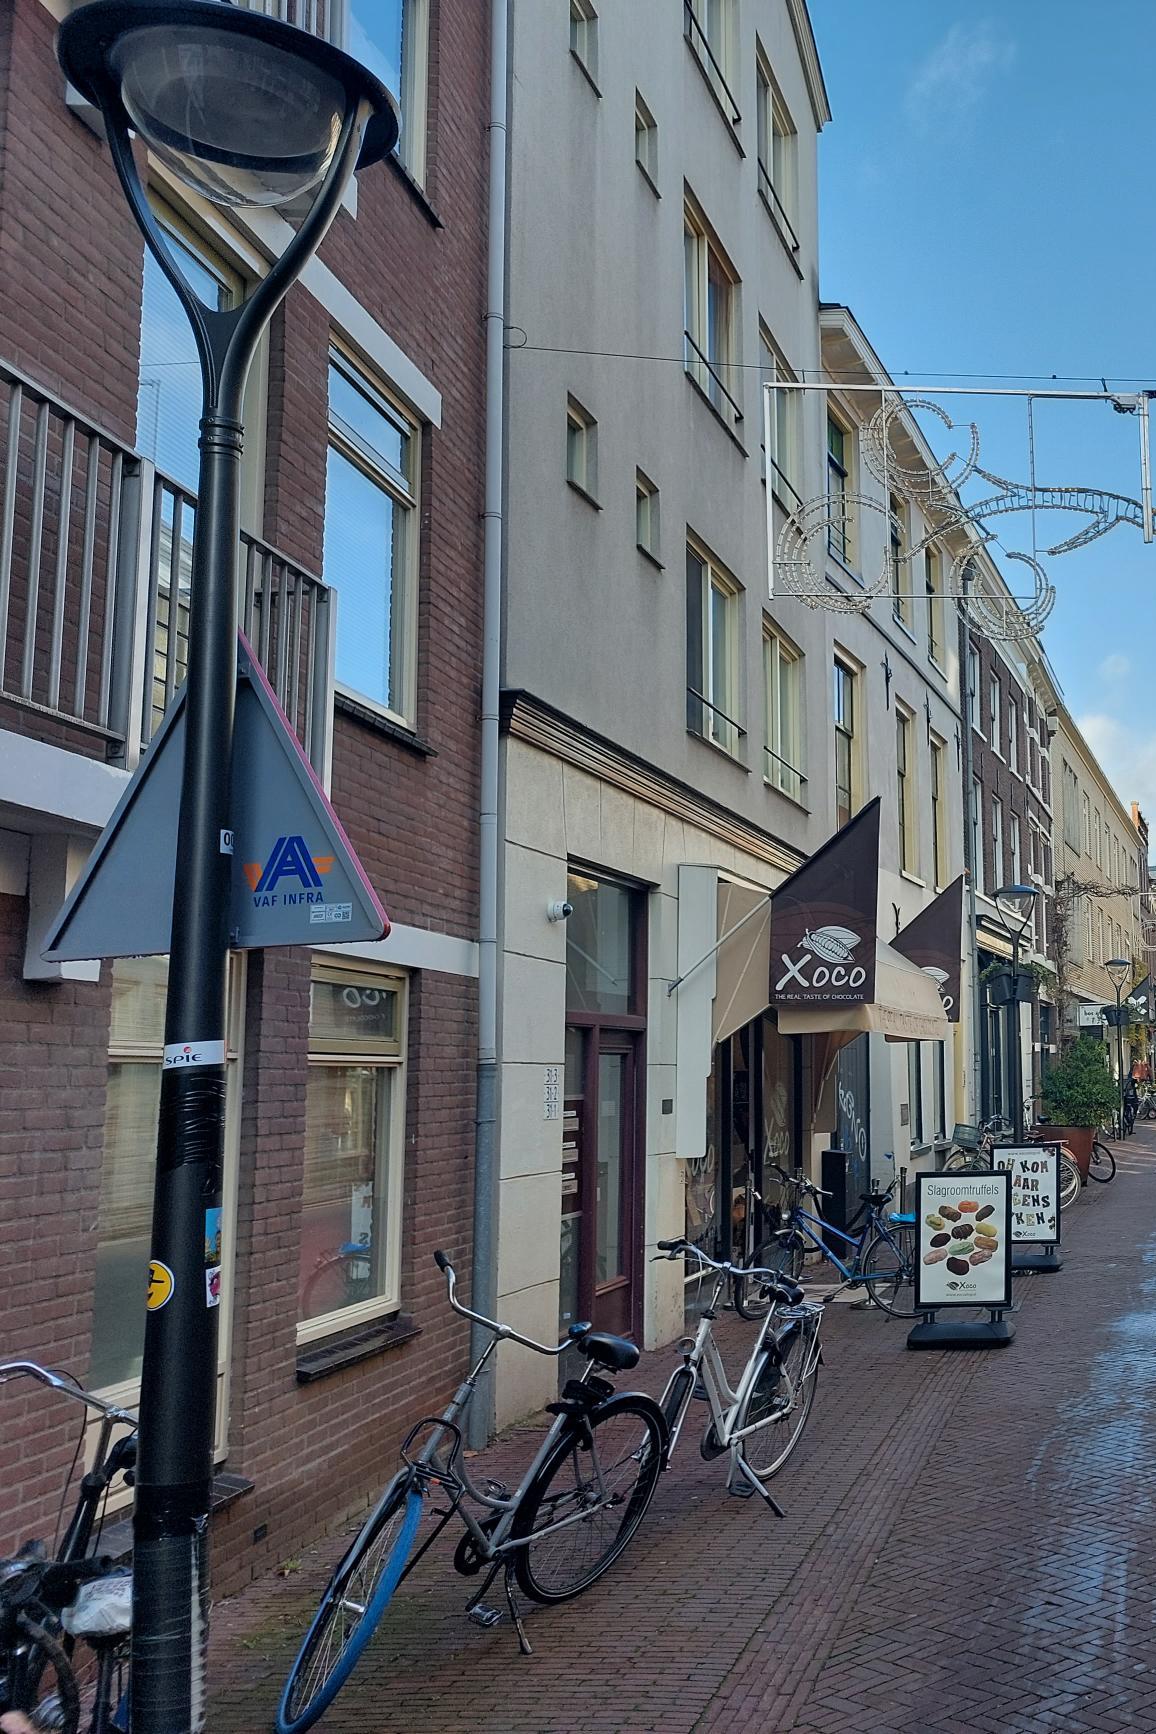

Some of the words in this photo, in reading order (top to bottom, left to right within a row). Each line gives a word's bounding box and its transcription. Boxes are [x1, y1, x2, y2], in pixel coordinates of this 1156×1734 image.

[253, 896, 277, 907] VAF
[283, 891, 323, 905] INFRA
[165, 1053, 203, 1065] SPIE
[1020, 1160, 1049, 1173] KOM
[1012, 1174, 1040, 1191] AAR
[927, 1184, 999, 1197] Slagroomtruffels
